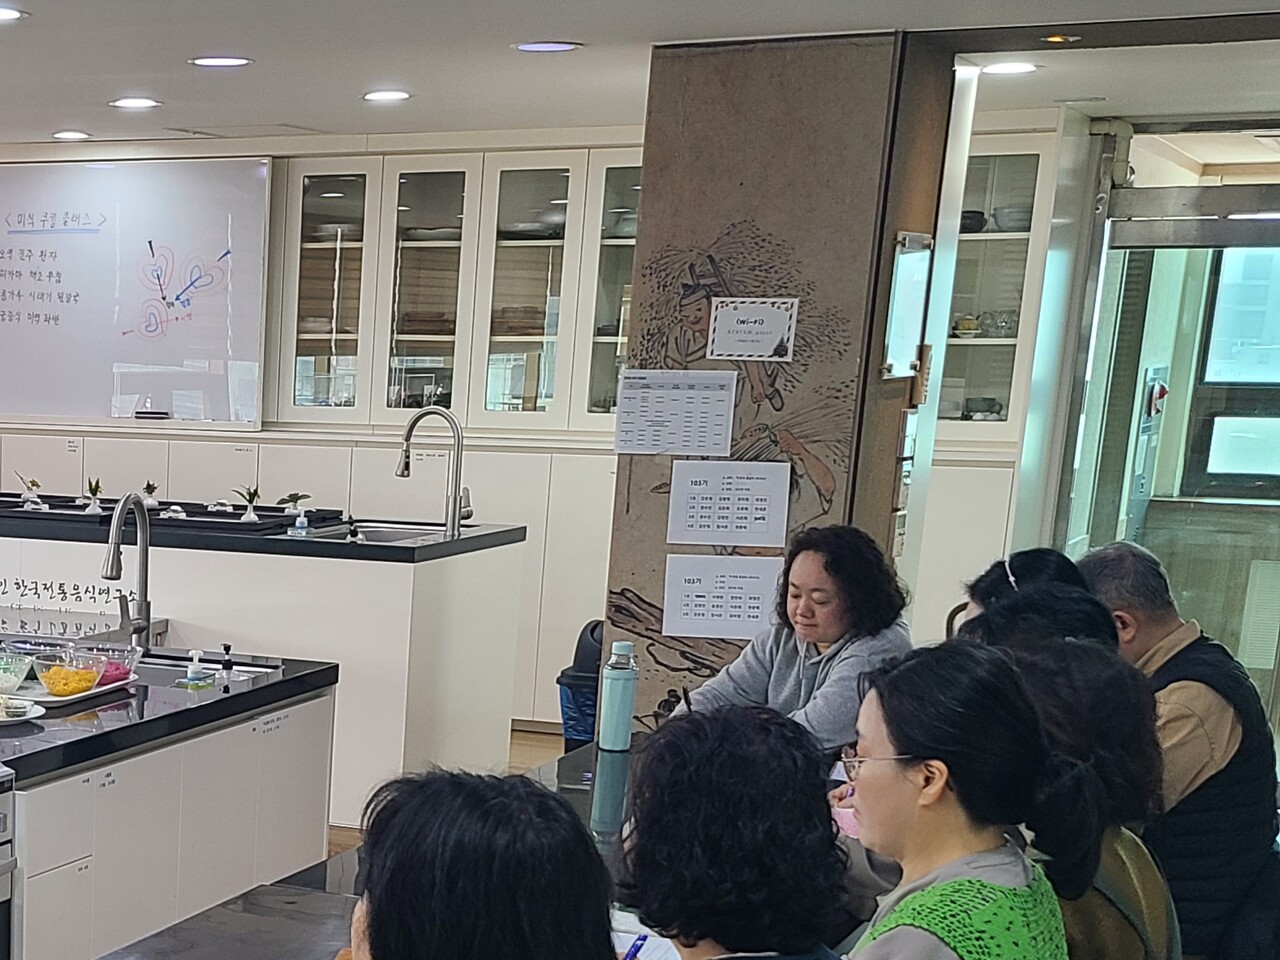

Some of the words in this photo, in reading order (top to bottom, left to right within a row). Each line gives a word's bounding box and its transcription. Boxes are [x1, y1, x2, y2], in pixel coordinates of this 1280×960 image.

[17, 212, 34, 228] 미식
[39, 211, 57, 229] 쿠킹
[62, 211, 92, 227] 클래스
[14, 577, 138, 604] 한국전통음식연구소
